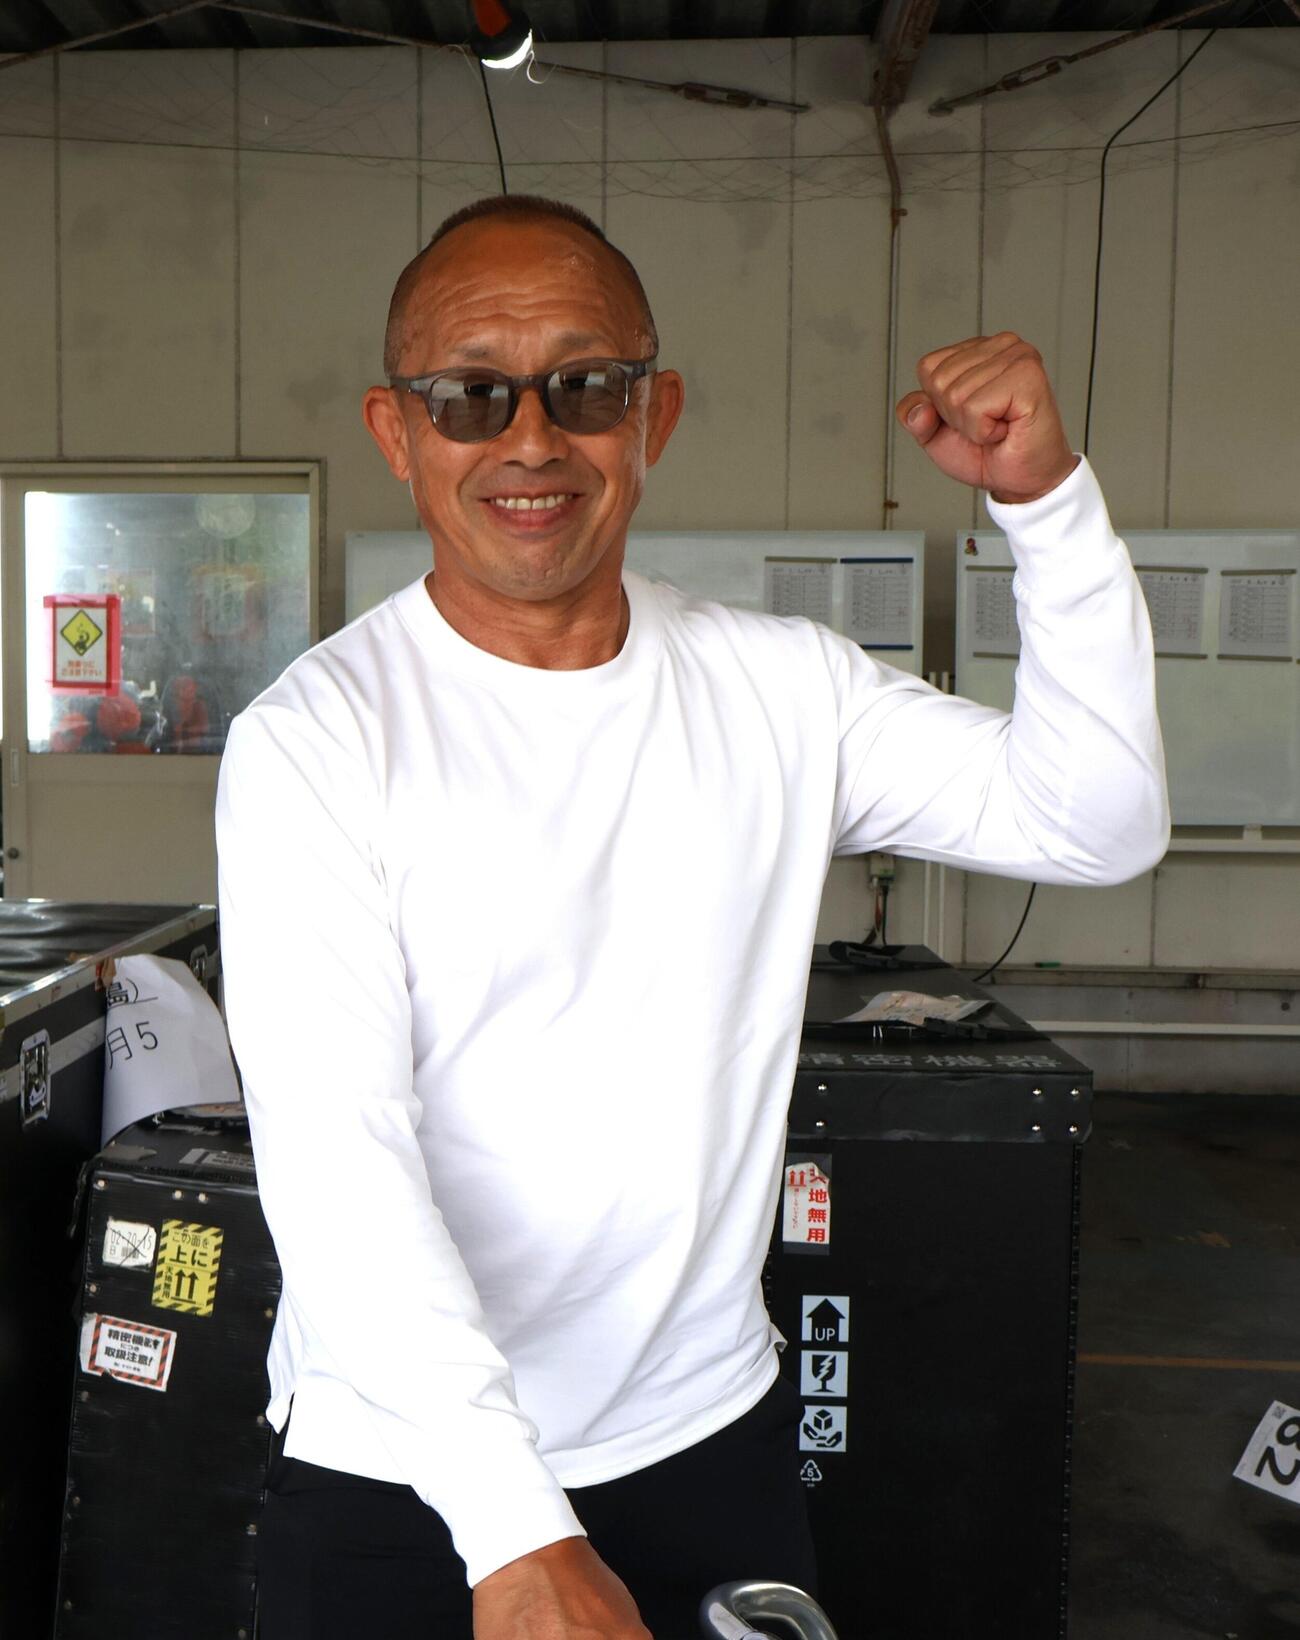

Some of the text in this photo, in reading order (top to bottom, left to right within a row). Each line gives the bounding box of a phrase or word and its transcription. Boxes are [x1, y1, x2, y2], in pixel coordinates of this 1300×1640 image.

[172, 1228, 210, 1249] この面を
[168, 1244, 208, 1268] 上に
[814, 1327, 836, 1342] UP
